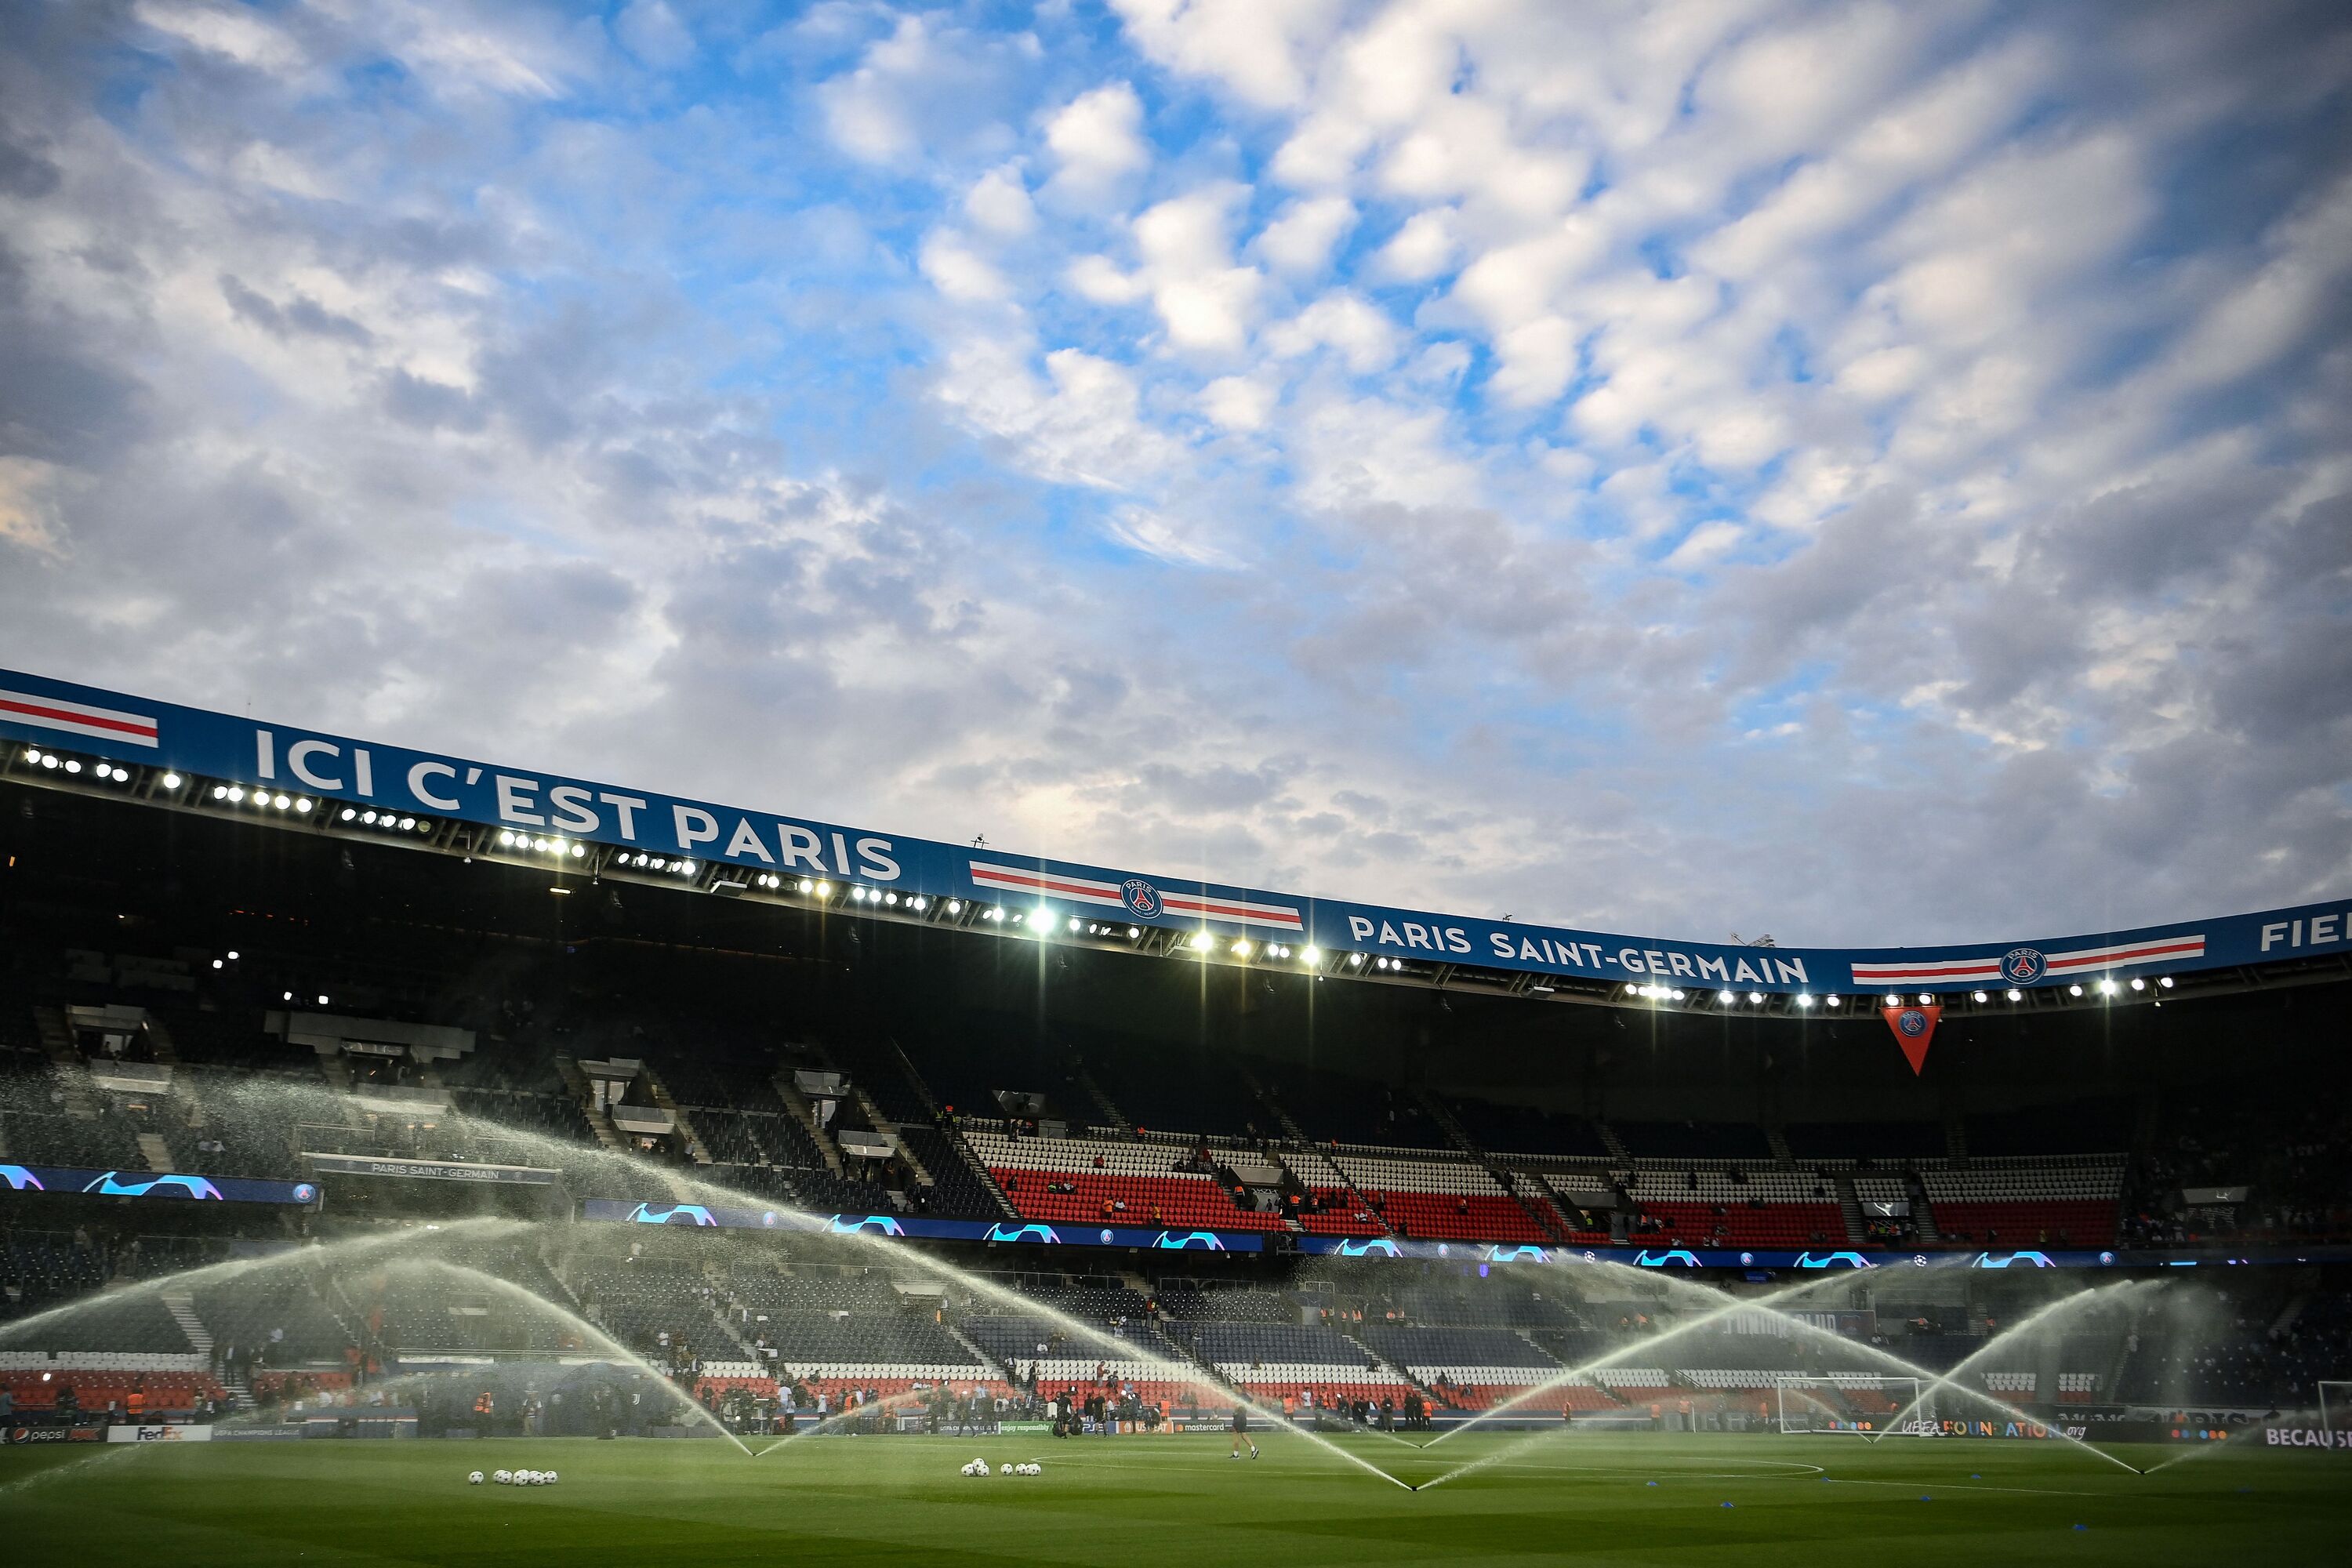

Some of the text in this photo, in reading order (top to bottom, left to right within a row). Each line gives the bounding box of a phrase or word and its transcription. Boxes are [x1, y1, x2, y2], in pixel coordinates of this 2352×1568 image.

[256, 729, 902, 881] ICI C'EST PARIS
[1126, 882, 1152, 893] PARIS
[1348, 916, 1809, 984] PARIS SAINT-GERMAIN
[2007, 949, 2038, 960] PARIS
[372, 1163, 499, 1178] PARIS SAINT-GERMAIN
[137, 1426, 183, 1441] FedEx
[1001, 1424, 1017, 1432] enjoy
[1185, 1423, 1225, 1432] mastercard
[31, 1429, 66, 1442] pepsi
